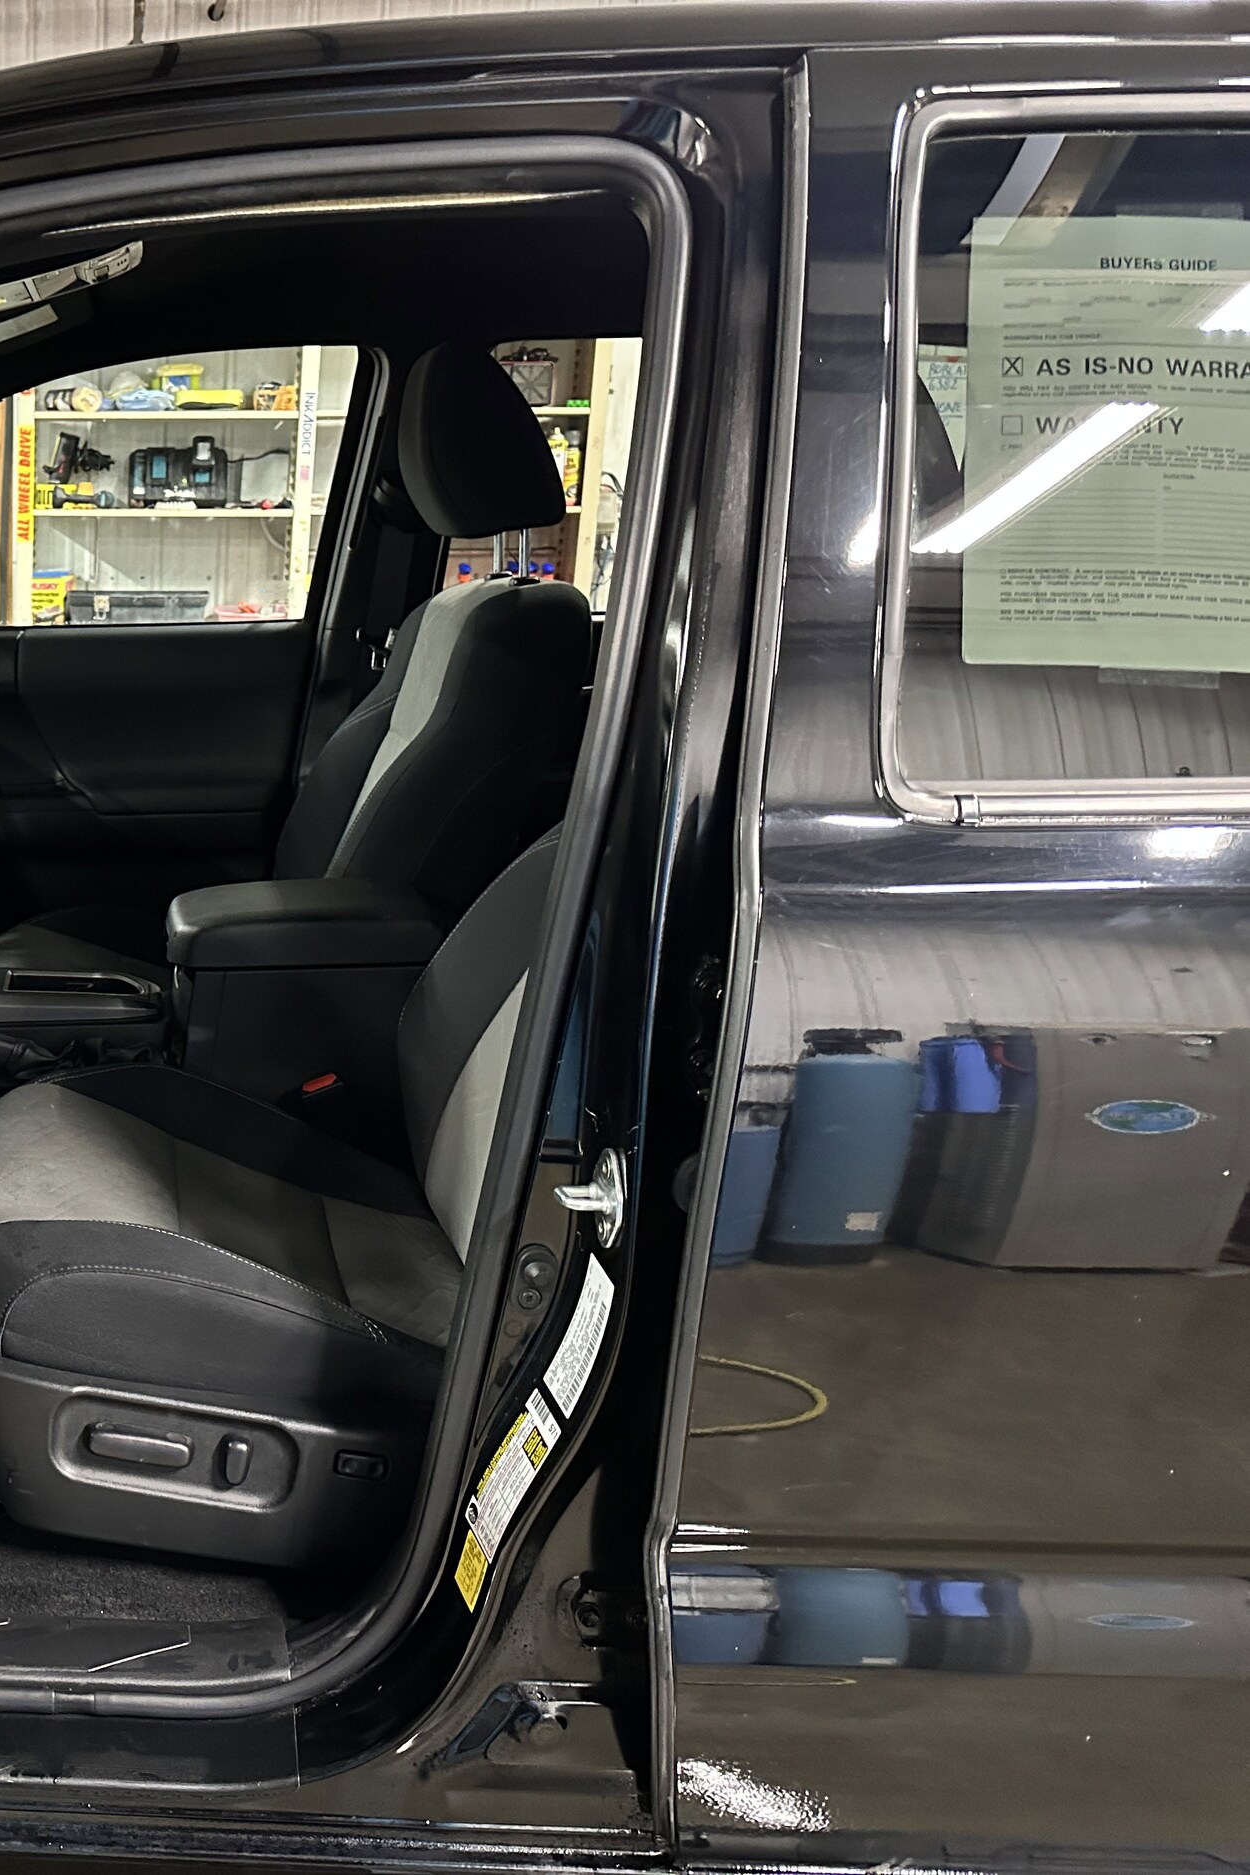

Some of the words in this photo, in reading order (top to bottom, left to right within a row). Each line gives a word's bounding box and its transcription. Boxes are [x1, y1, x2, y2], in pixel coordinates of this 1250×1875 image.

[1100, 257, 1163, 271] BUYERS
[1169, 259, 1218, 273] GUIDE
[1036, 358, 1071, 376] AS
[1084, 357, 1154, 375] IS-NO
[1036, 416, 1184, 435] WANTY
[19, 427, 32, 468] DRIVE
[18, 472, 31, 514] WHEEL
[17, 518, 30, 541] ALL
